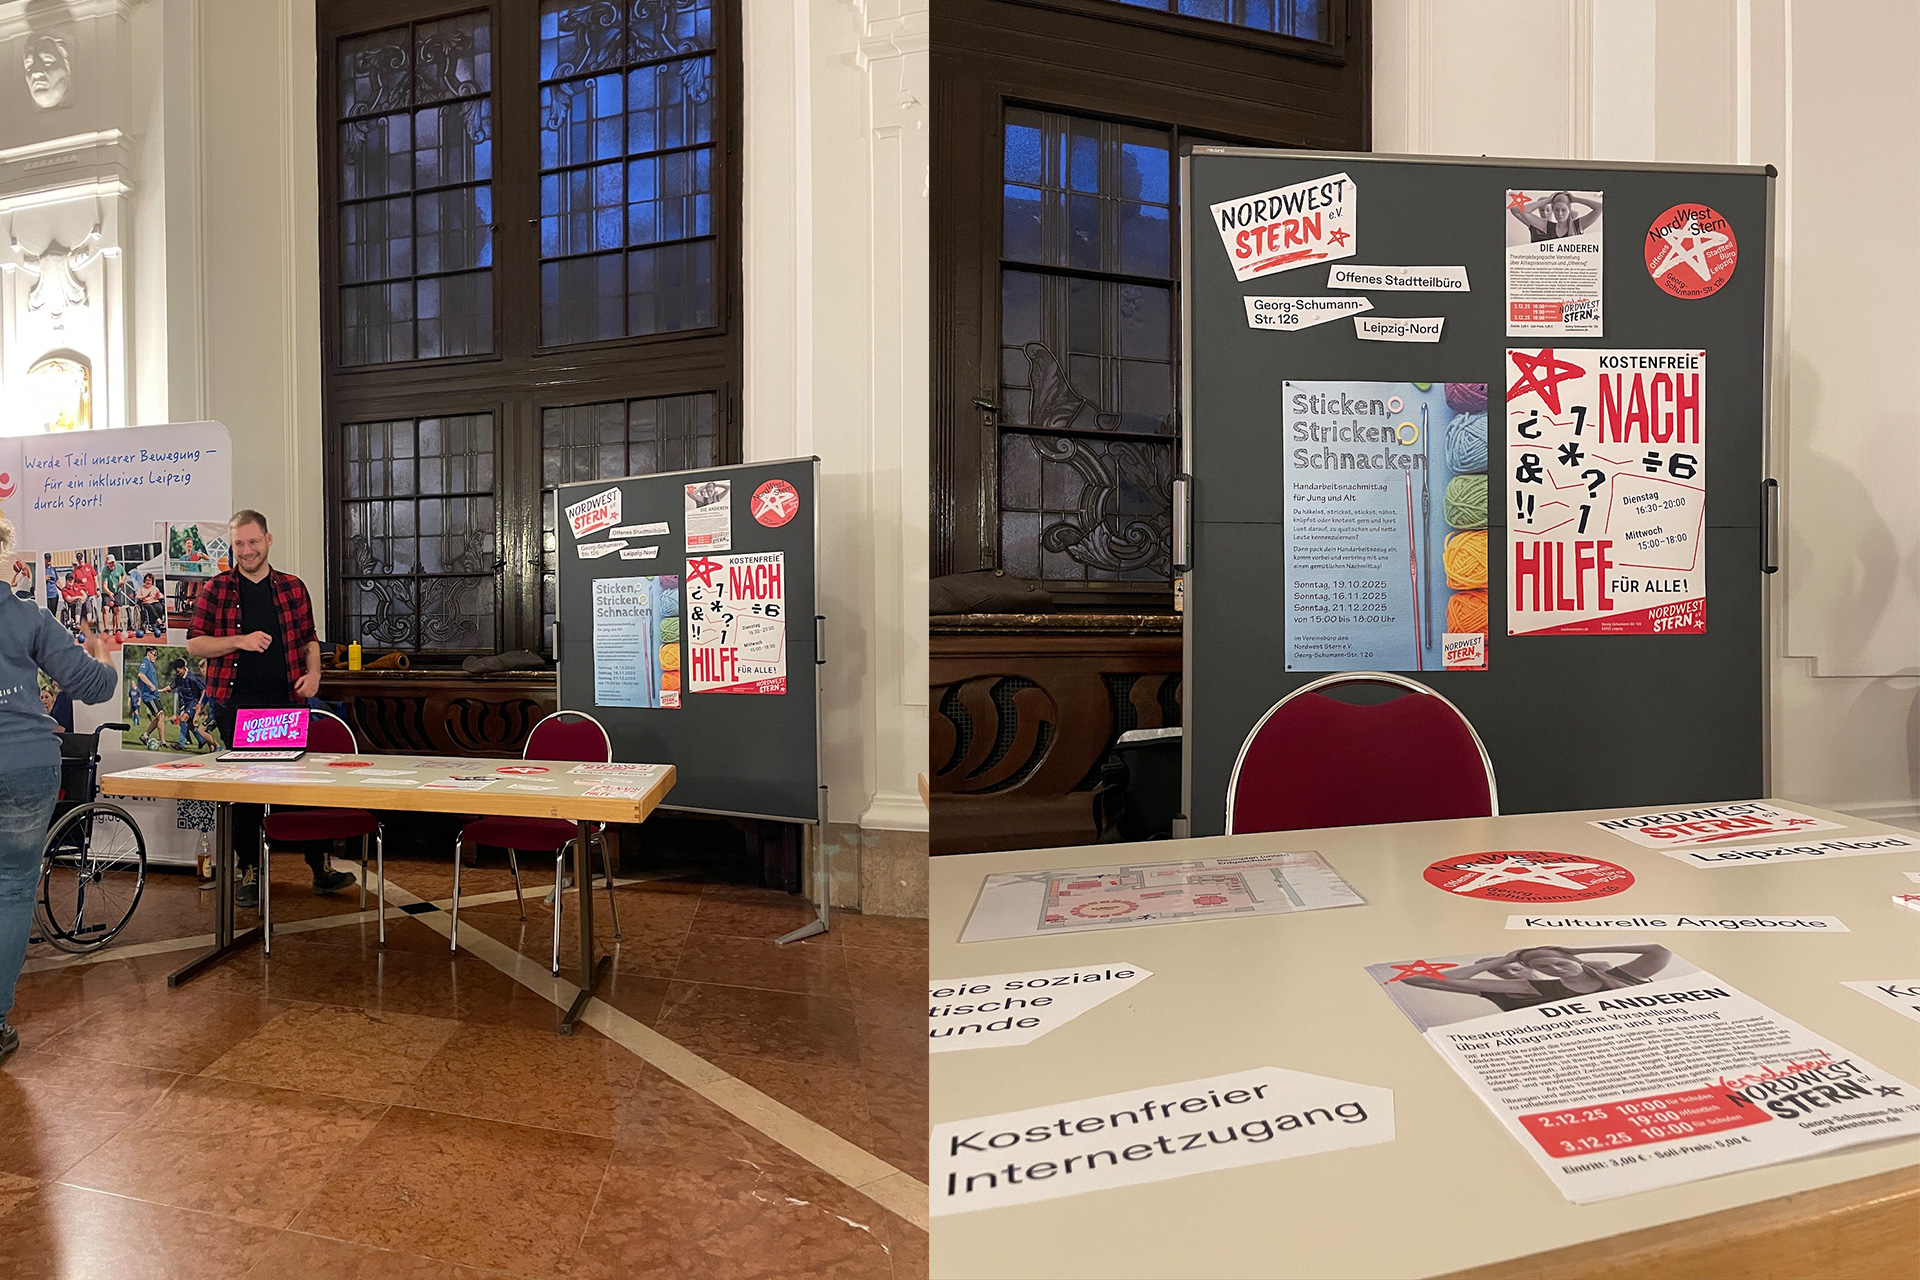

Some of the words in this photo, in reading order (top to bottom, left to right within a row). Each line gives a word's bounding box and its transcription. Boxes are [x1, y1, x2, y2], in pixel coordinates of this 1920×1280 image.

[1221, 178, 1347, 232] NORDWEST
[1235, 212, 1322, 259] STERN
[1328, 206, 1343, 220] e.V.
[1649, 207, 1711, 242] NordWest
[1691, 218, 1726, 236] Stern
[1540, 243, 1555, 253] DIE
[1557, 244, 1599, 253] ANDEREN
[1649, 244, 1669, 269] Offenes
[1706, 241, 1733, 258] Stadtteil
[1719, 250, 1736, 260] Büro
[1709, 257, 1733, 274] Leipzig
[1335, 271, 1382, 286] Offenes
[1385, 274, 1462, 289] Stadtteilbüro
[1666, 272, 1688, 289] Georg-
[1714, 277, 1725, 288] 126
[1253, 299, 1363, 312] Georg-Schumann-
[1559, 300, 1600, 314] NORDWEST
[1254, 314, 1276, 324] Str.
[1277, 314, 1299, 324] 126
[1563, 309, 1593, 323] STERN
[1363, 321, 1439, 336] Leipzig-Nord
[1293, 393, 1392, 419] Sticken,
[1599, 372, 1699, 444] NACH
[1293, 420, 1402, 446] Stricken,
[25, 452, 60, 470] Werde
[65, 451, 87, 467] Teil
[92, 452, 135, 467] unserer
[140, 449, 200, 465] Bewegung
[1293, 447, 1428, 470] Schnacken
[44, 476, 62, 493] für
[67, 476, 84, 490] ein
[88, 472, 144, 488] inklusives
[148, 470, 191, 486] Leipzig
[752, 481, 785, 501] NordWest
[1293, 482, 1388, 492] Handarbeitsnachmittag
[34, 494, 65, 510] durch
[68, 492, 103, 510] Sport!
[568, 489, 617, 519] NORDWEST
[1307, 494, 1326, 503] Jung
[1622, 491, 1659, 505] Dienstag
[574, 506, 608, 530] STERN
[1625, 526, 1663, 540] Mittwoch
[623, 550, 656, 558] Leipzig-Nord
[730, 564, 781, 600] NACH
[1515, 540, 1614, 611] HILFE
[1611, 575, 1639, 593] FÜR
[1645, 579, 1689, 593] ALLE!
[1294, 581, 1331, 591] Sonntag,
[1332, 581, 1387, 589] 19.10.2025
[1294, 592, 1331, 601] Sonntag,
[1332, 592, 1387, 600] 16.11.2025
[597, 607, 652, 618] Schnacken
[1294, 604, 1331, 613] Sonntag,
[1332, 604, 1387, 612] 21.12.2025
[1648, 600, 1704, 620] NORDWEST
[1310, 615, 1337, 623] 15:00
[1338, 615, 1351, 623] bis
[1353, 615, 1379, 623] 18:00
[1381, 615, 1395, 623] Uhr
[1653, 613, 1693, 633] STERN
[1444, 637, 1482, 652] NORDWEST
[1447, 646, 1475, 660] STERN
[691, 647, 739, 682] HILFE
[738, 664, 752, 673] FÜR
[754, 666, 777, 674] ALLE!
[759, 684, 779, 694] STERN
[242, 711, 302, 731] NORDWEST
[246, 724, 288, 743] STERN
[1598, 802, 1768, 832] NORDWEST
[1639, 815, 1773, 842] STERN
[1691, 837, 1912, 864] Leipzig-Nord
[1430, 852, 1553, 873] NordWest
[1515, 855, 1587, 867] Stern
[1525, 917, 1667, 929] Kulturelle
[1676, 916, 1828, 932] Angebote
[1004, 967, 1136, 992] soziale
[1537, 1003, 1592, 1018] DIE
[1598, 988, 1731, 1012] ANDEREN
[1447, 1014, 1607, 1042] Theaterpädagogische
[1608, 1007, 1689, 1025] Vorstellung
[1455, 1042, 1490, 1052] über
[1495, 1022, 1622, 1047] Alltagsrassismus
[1624, 1019, 1653, 1029] und
[1727, 1059, 1864, 1108] NORDWEST
[1767, 1080, 1874, 1119] STERN
[950, 1083, 1269, 1157] Kostenfreier
[1538, 1108, 1608, 1128] 2.12.25
[1616, 1098, 1668, 1116] 10:00
[1679, 1093, 1714, 1103] Schulen
[1628, 1110, 1680, 1127] 19:00
[1679, 1104, 1721, 1116] öffentlich
[1799, 1106, 1907, 1130] Georg-Schumann-Str.
[1812, 1116, 1901, 1137] nordweststern.de
[1560, 1132, 1633, 1152] 3.12.25
[1640, 1122, 1694, 1139] 10:00
[947, 1100, 1369, 1196] Internetzugang
[1562, 1160, 1608, 1175] Eintritt:
[1609, 1155, 1638, 1167] 3,00
[1638, 1154, 1647, 1162] €
[1654, 1141, 1716, 1160] Soll-Preis:
[1743, 1135, 1752, 1143] €
